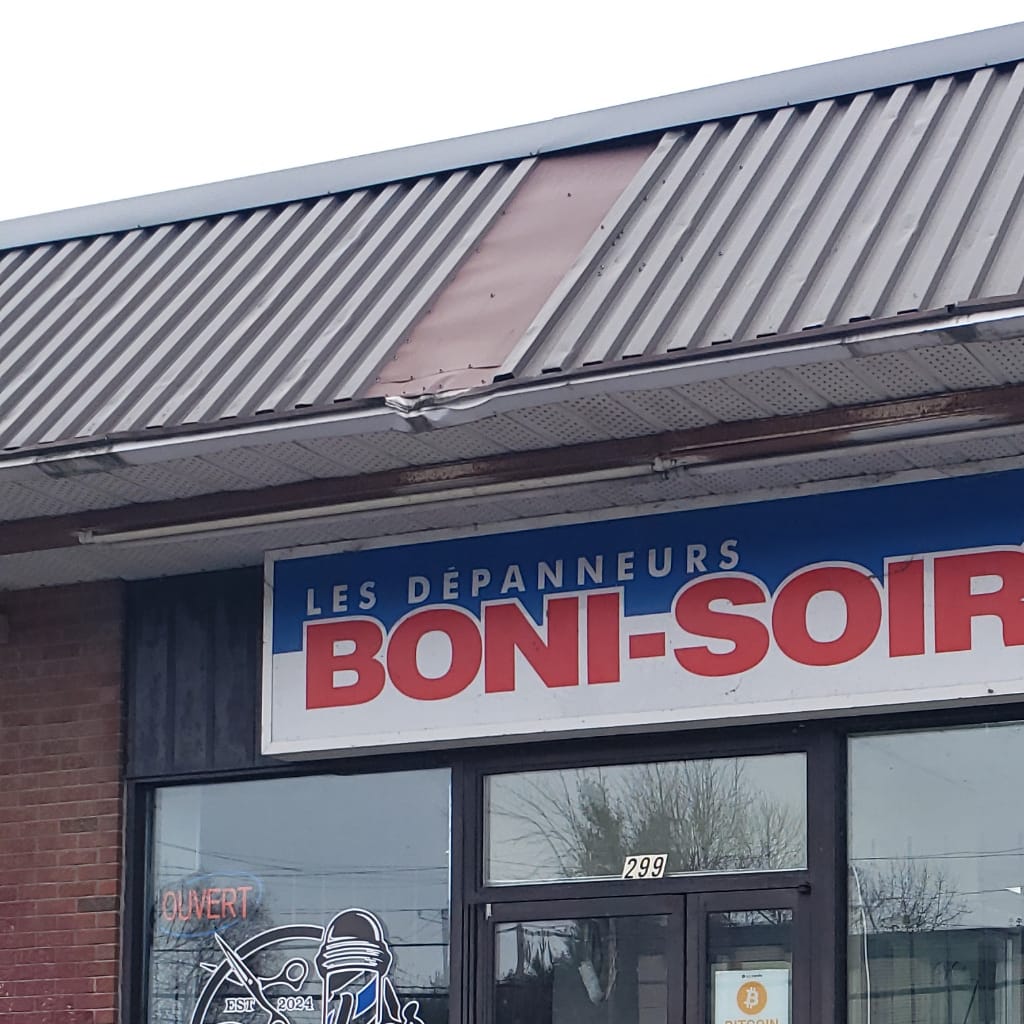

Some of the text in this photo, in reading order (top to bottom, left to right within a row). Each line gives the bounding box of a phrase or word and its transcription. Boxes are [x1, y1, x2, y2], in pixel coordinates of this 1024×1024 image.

[306, 539, 740, 616] LES DÉPANNEURS
[624, 856, 665, 879] 299
[162, 885, 254, 921] OUVERT
[223, 996, 315, 1013] EST 2024
